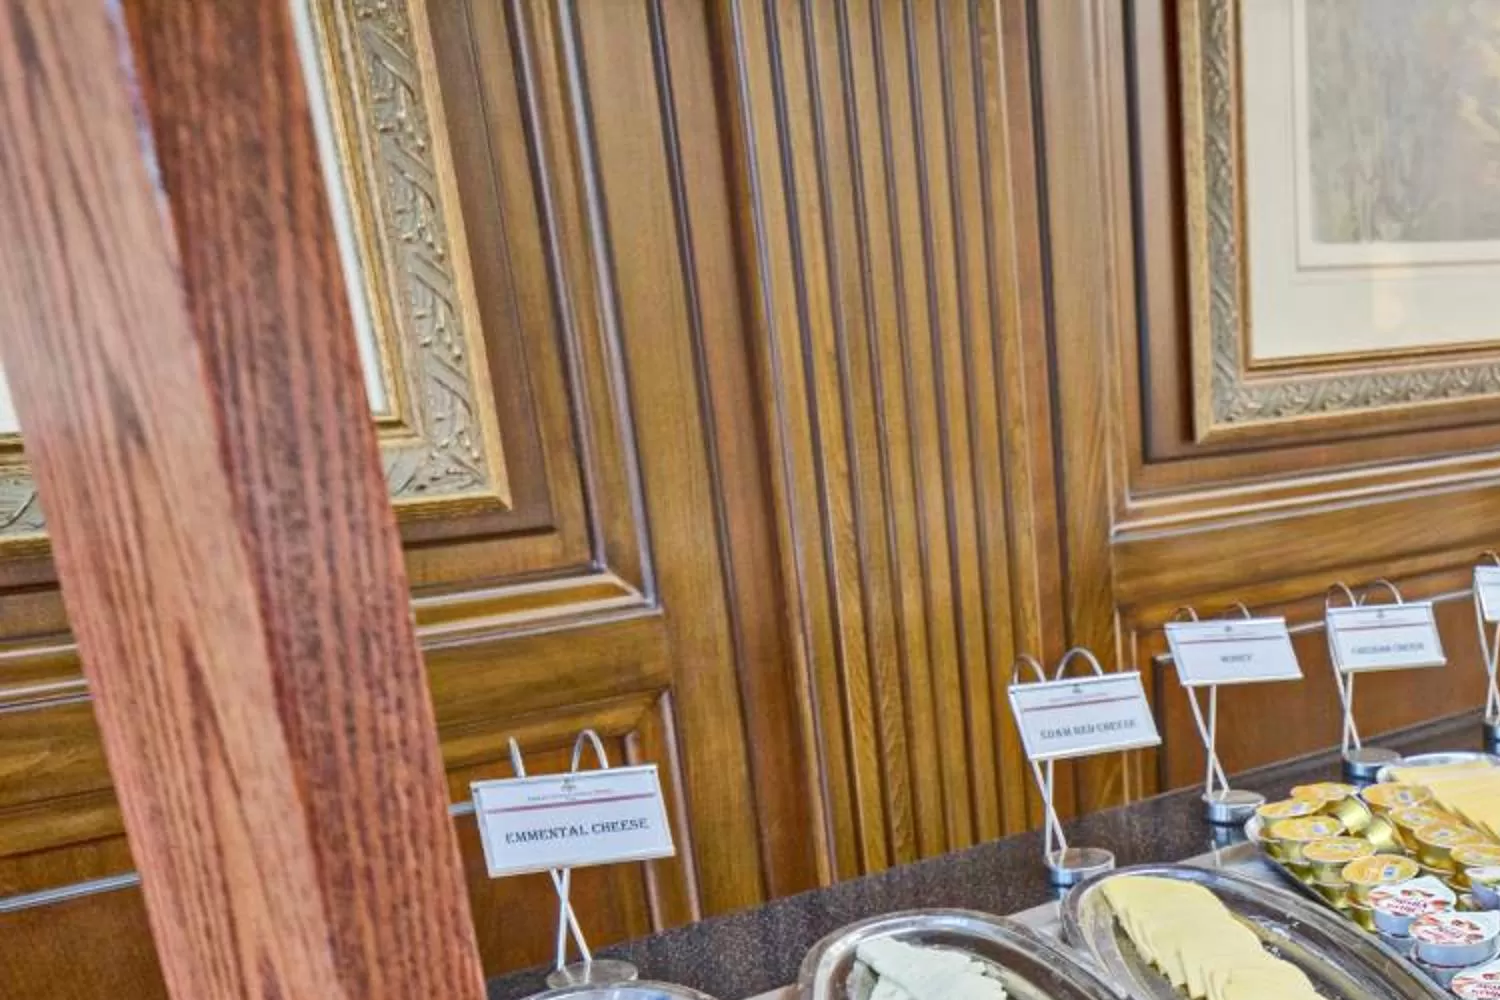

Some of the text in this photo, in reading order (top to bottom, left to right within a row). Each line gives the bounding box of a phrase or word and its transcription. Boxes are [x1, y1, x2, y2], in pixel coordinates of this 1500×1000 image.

[1096, 718, 1138, 733] CHEESE
[504, 817, 651, 845] EMMENTAL CHEESE
